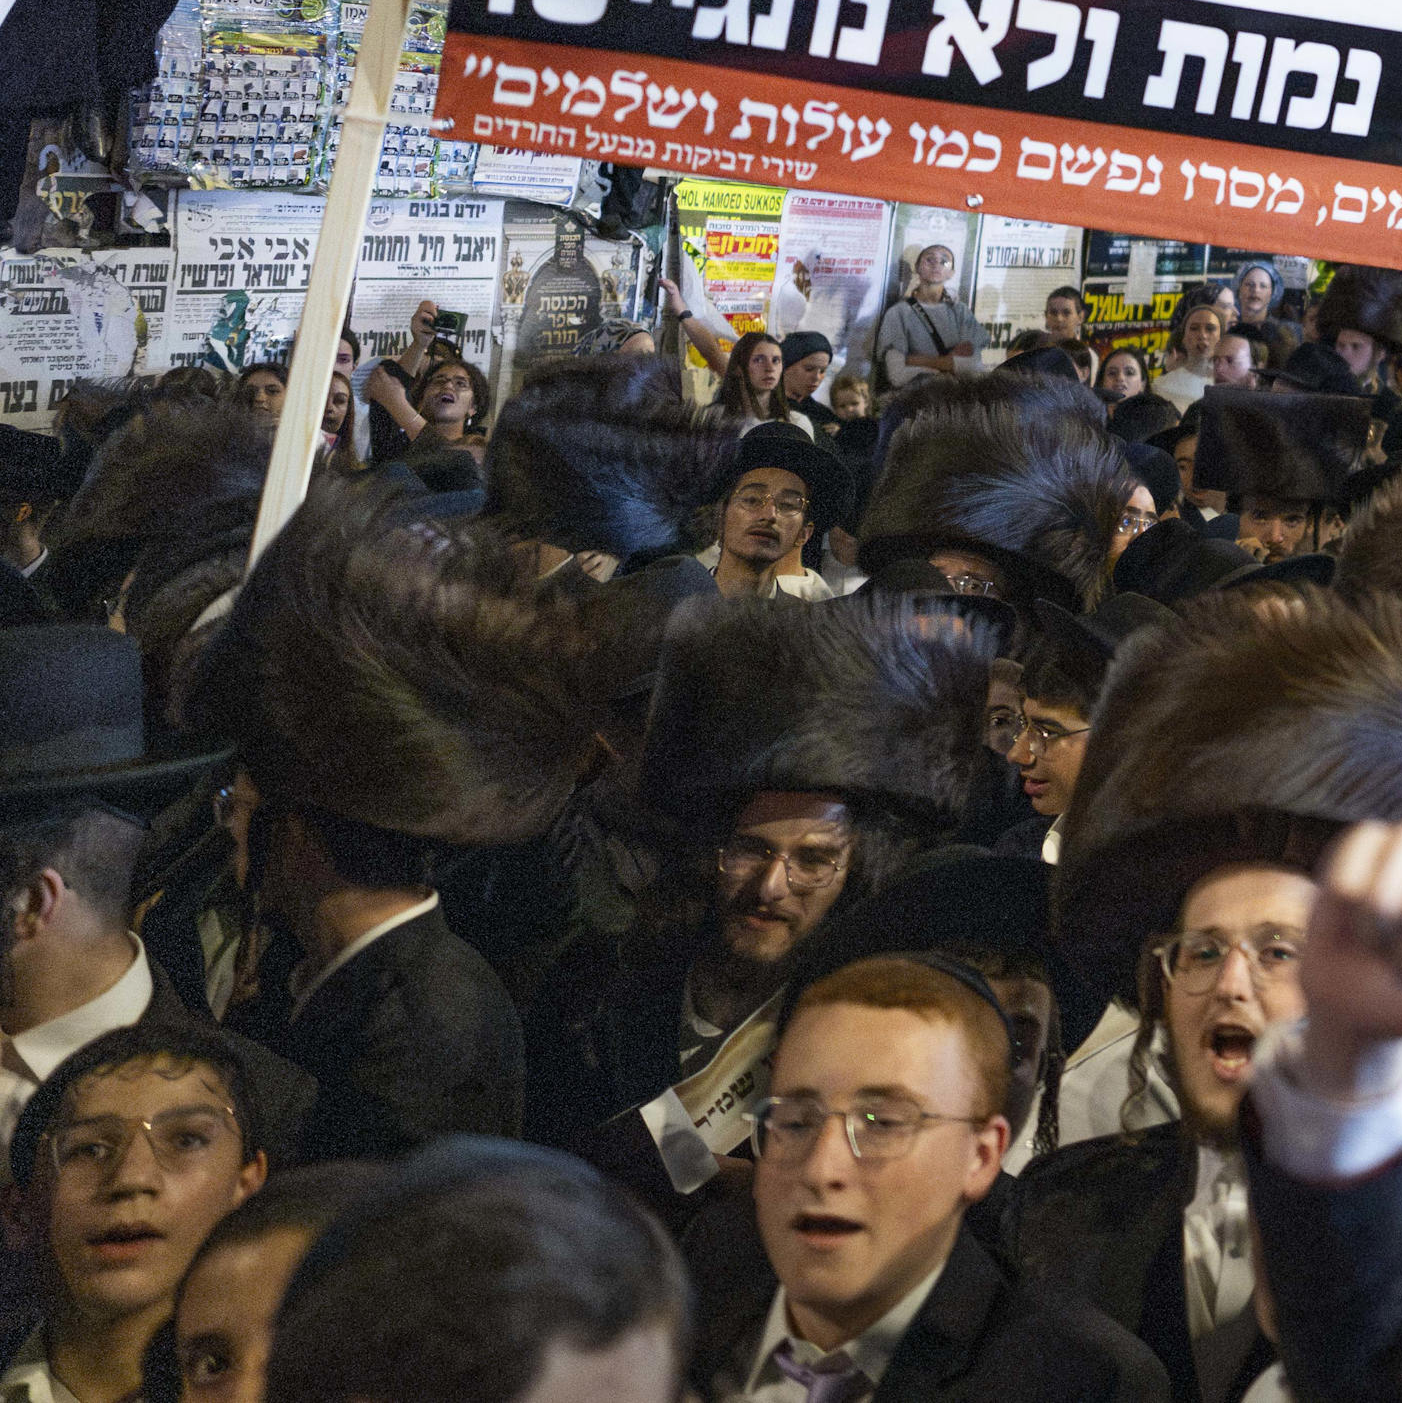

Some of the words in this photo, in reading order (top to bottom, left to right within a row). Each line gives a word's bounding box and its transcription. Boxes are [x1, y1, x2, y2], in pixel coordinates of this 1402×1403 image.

[344, 4, 369, 22] אמן
[1142, 18, 1383, 137] נמות
[472, 112, 578, 151] החרדים
[585, 125, 657, 162] מבעל
[729, 98, 894, 163] עולות
[660, 140, 755, 174] דביקות
[908, 121, 1003, 174] כמו
[761, 154, 819, 182] שירי
[1014, 136, 1164, 197] נפשם
[678, 190, 699, 206] HOL
[703, 191, 741, 210] HAMOED
[744, 193, 781, 211] SUKKOS
[1179, 159, 1306, 216] מסרו
[409, 202, 450, 218] בגוים
[454, 203, 486, 218] יודע
[209, 236, 255, 260] אבי
[265, 237, 310, 260] אבי
[362, 235, 410, 262] וחומה
[418, 233, 445, 262] חיל
[453, 233, 496, 262] ויאבל
[986, 245, 1019, 267] הקודש
[1022, 246, 1044, 267] ארון
[1048, 247, 1076, 266] נשבה
[180, 263, 235, 288] ופרשיו
[242, 262, 295, 288] ישראל
[539, 295, 588, 311] הכנסת
